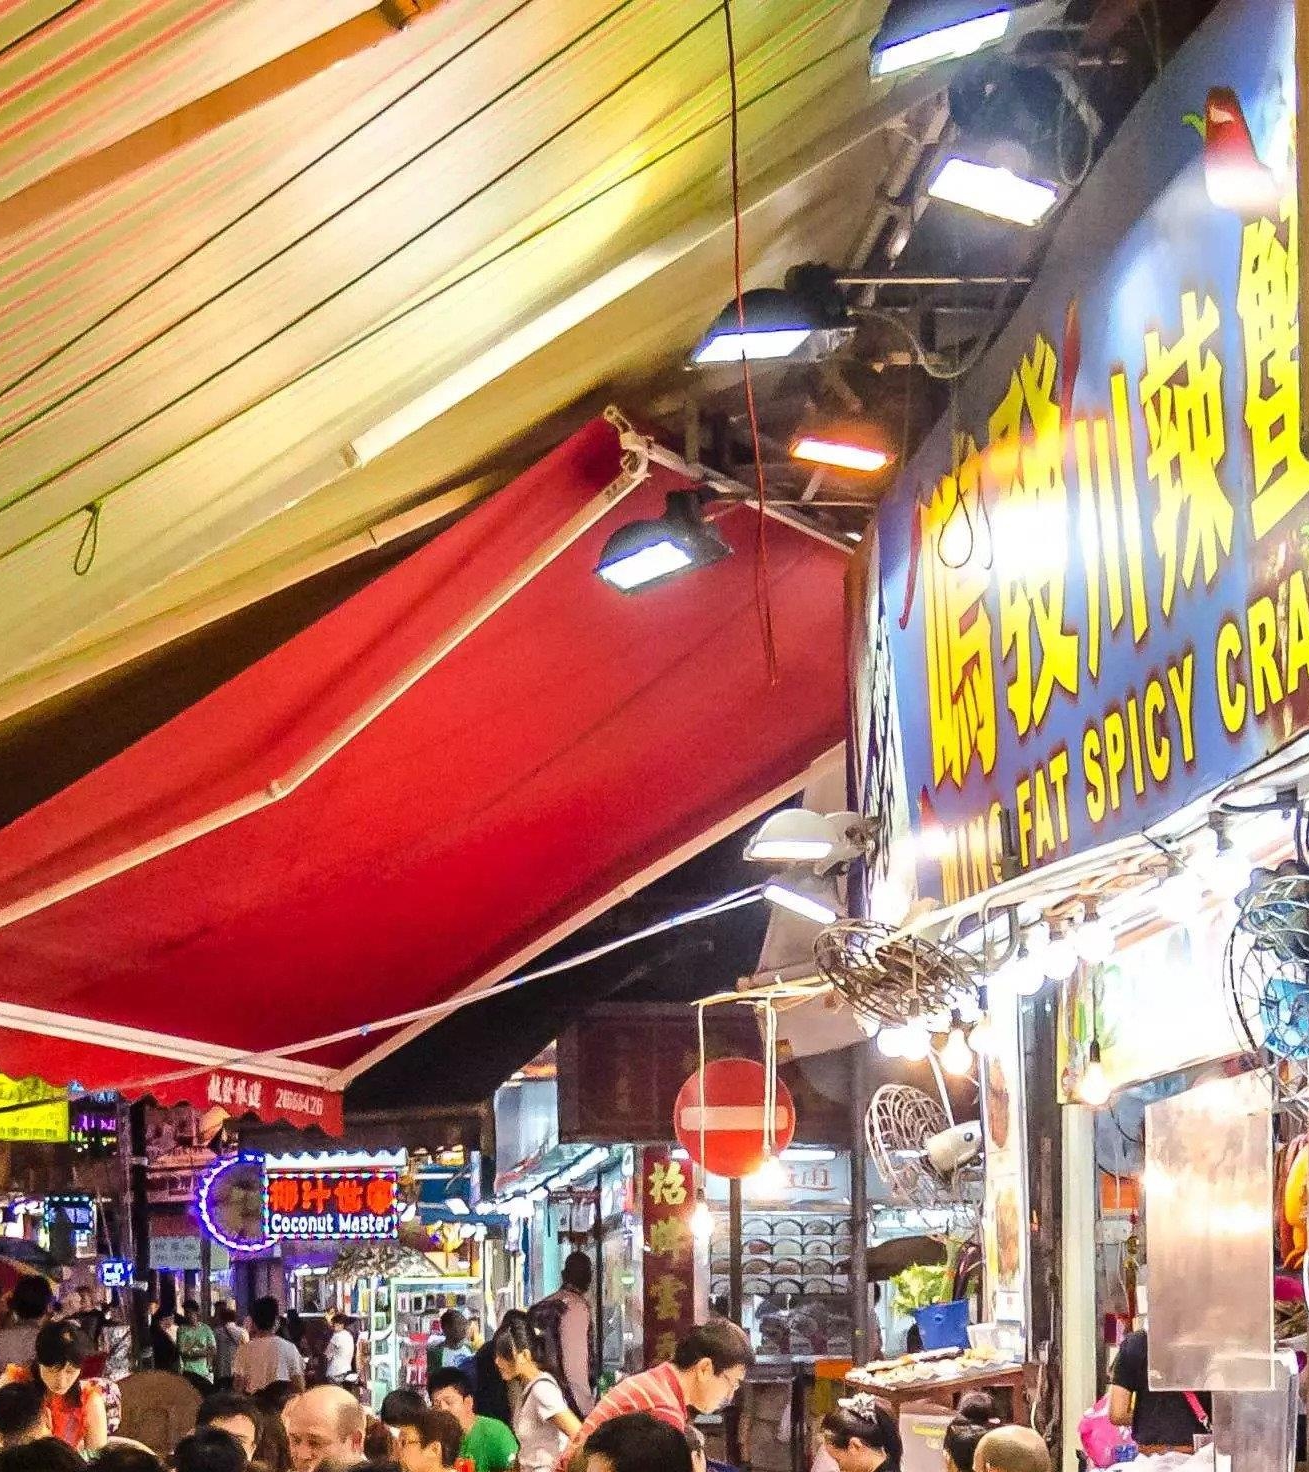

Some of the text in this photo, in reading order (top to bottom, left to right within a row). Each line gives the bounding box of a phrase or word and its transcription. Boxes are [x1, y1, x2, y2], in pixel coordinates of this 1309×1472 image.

[1016, 752, 1069, 868] FAT
[1083, 654, 1194, 823] SPICY
[271, 1213, 392, 1233] Coconut Master
